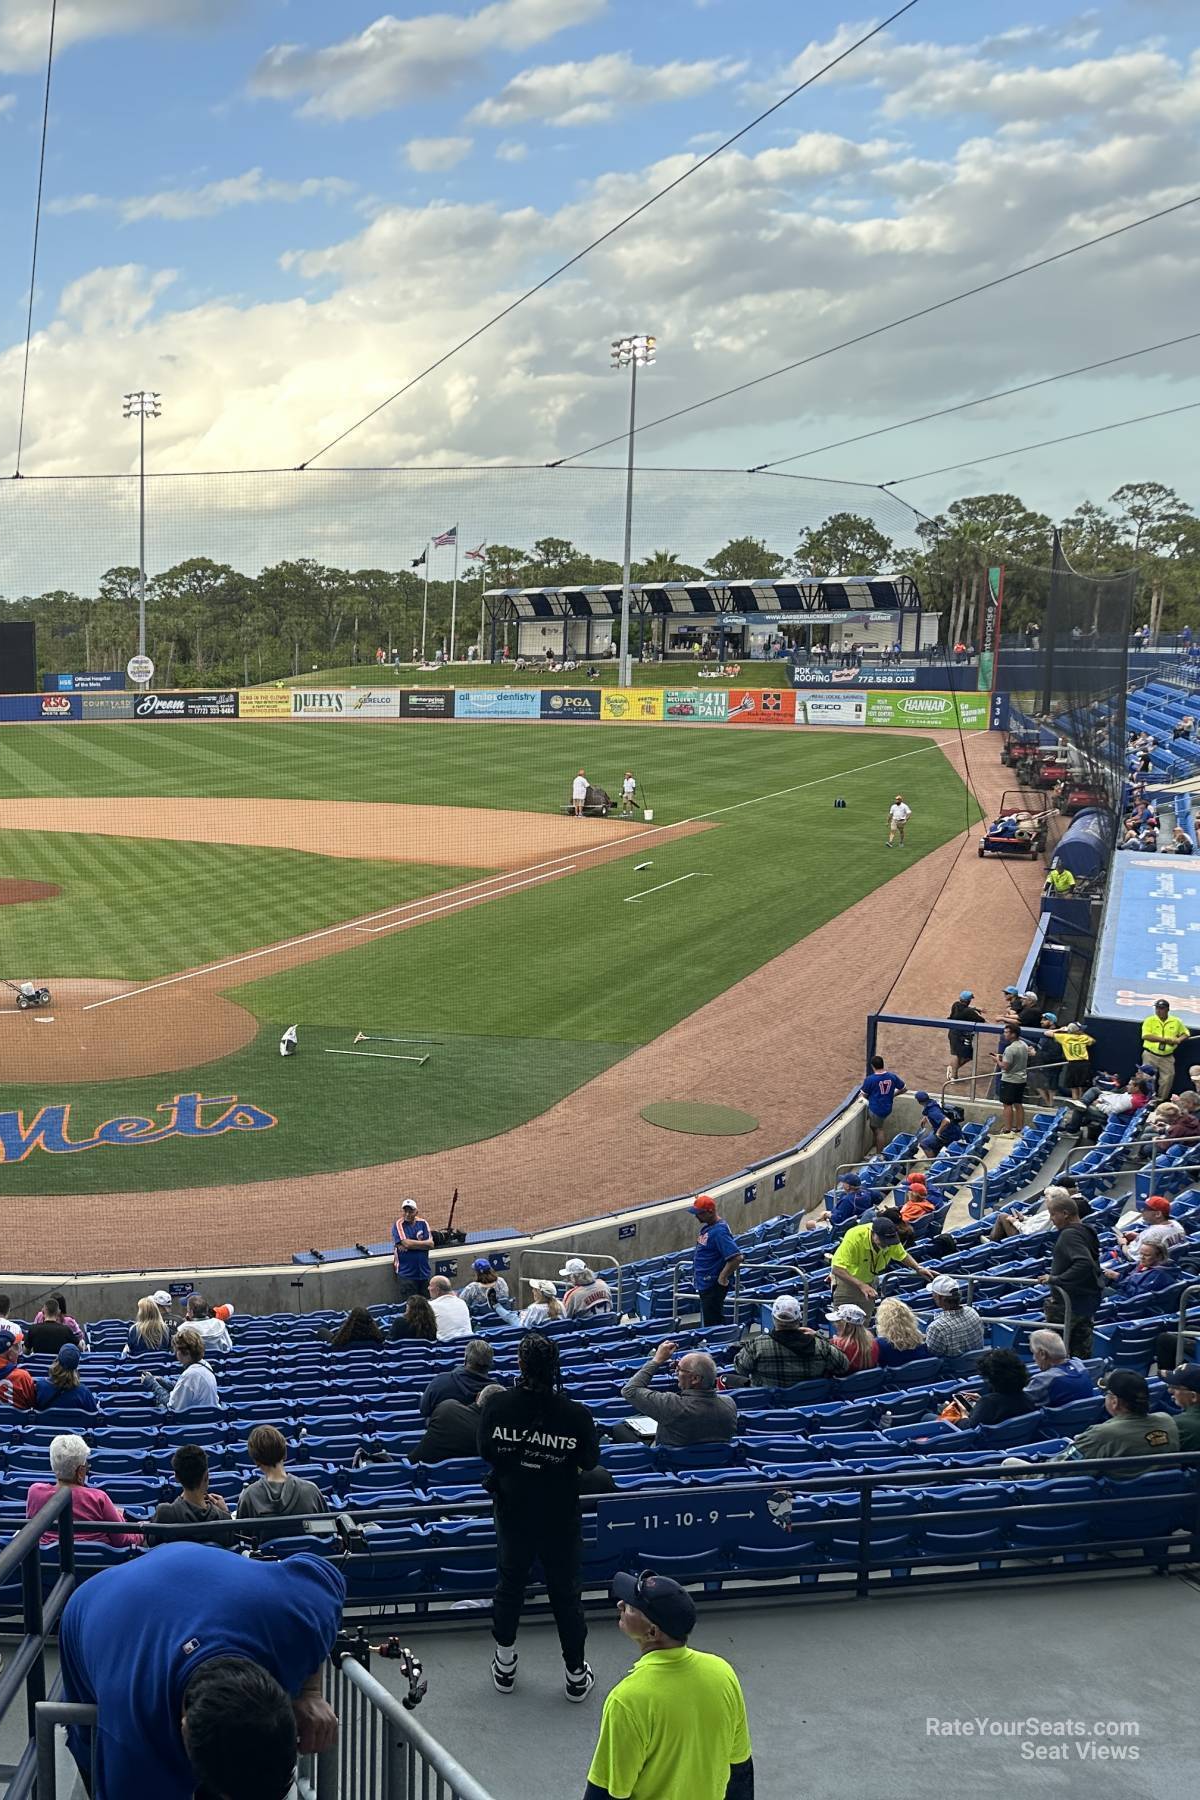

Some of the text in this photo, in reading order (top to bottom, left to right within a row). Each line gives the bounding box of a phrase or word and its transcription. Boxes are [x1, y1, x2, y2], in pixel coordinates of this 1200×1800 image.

[794, 667, 810, 675] PDX
[794, 674, 831, 683] ROOFING
[137, 696, 185, 715] Dream
[564, 697, 592, 707] PGA
[704, 693, 726, 706] 411
[903, 699, 946, 711] HANNAN
[699, 705, 726, 717] PAIN
[811, 703, 841, 711] GEICO
[879, 1080, 892, 1095] 17
[491, 1426, 578, 1450] ALLSAINTS
[643, 1510, 720, 1529] 11 10 9
